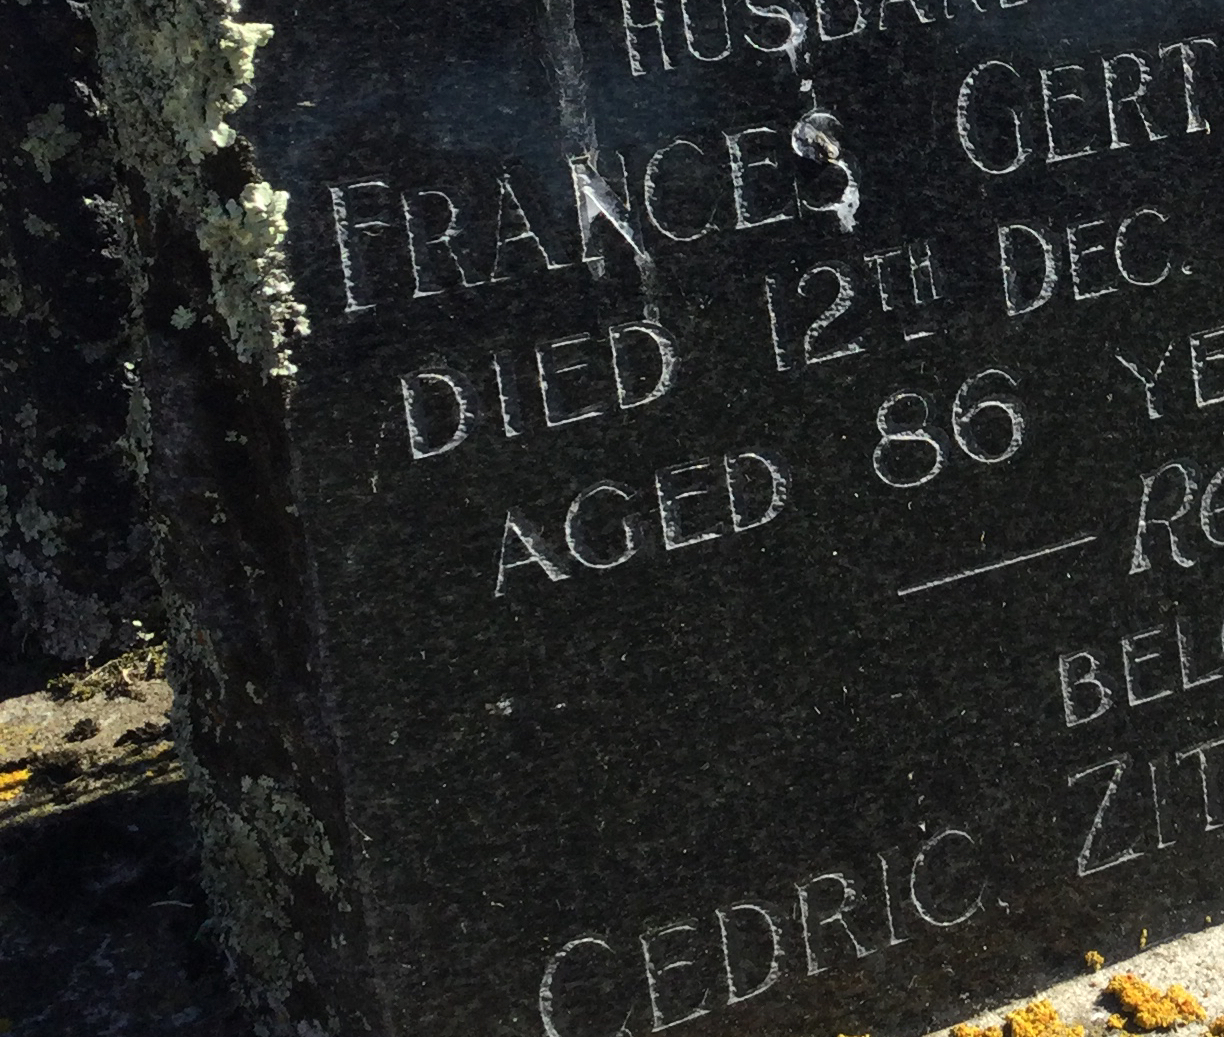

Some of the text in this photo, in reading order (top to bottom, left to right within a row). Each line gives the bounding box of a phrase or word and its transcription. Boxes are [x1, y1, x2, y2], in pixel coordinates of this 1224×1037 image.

[328, 112, 862, 316] FRANCES
[400, 316, 678, 461] DIED
[1000, 207, 1194, 316] DEC.
[492, 450, 790, 599] AGED
[872, 368, 1026, 489] 86
